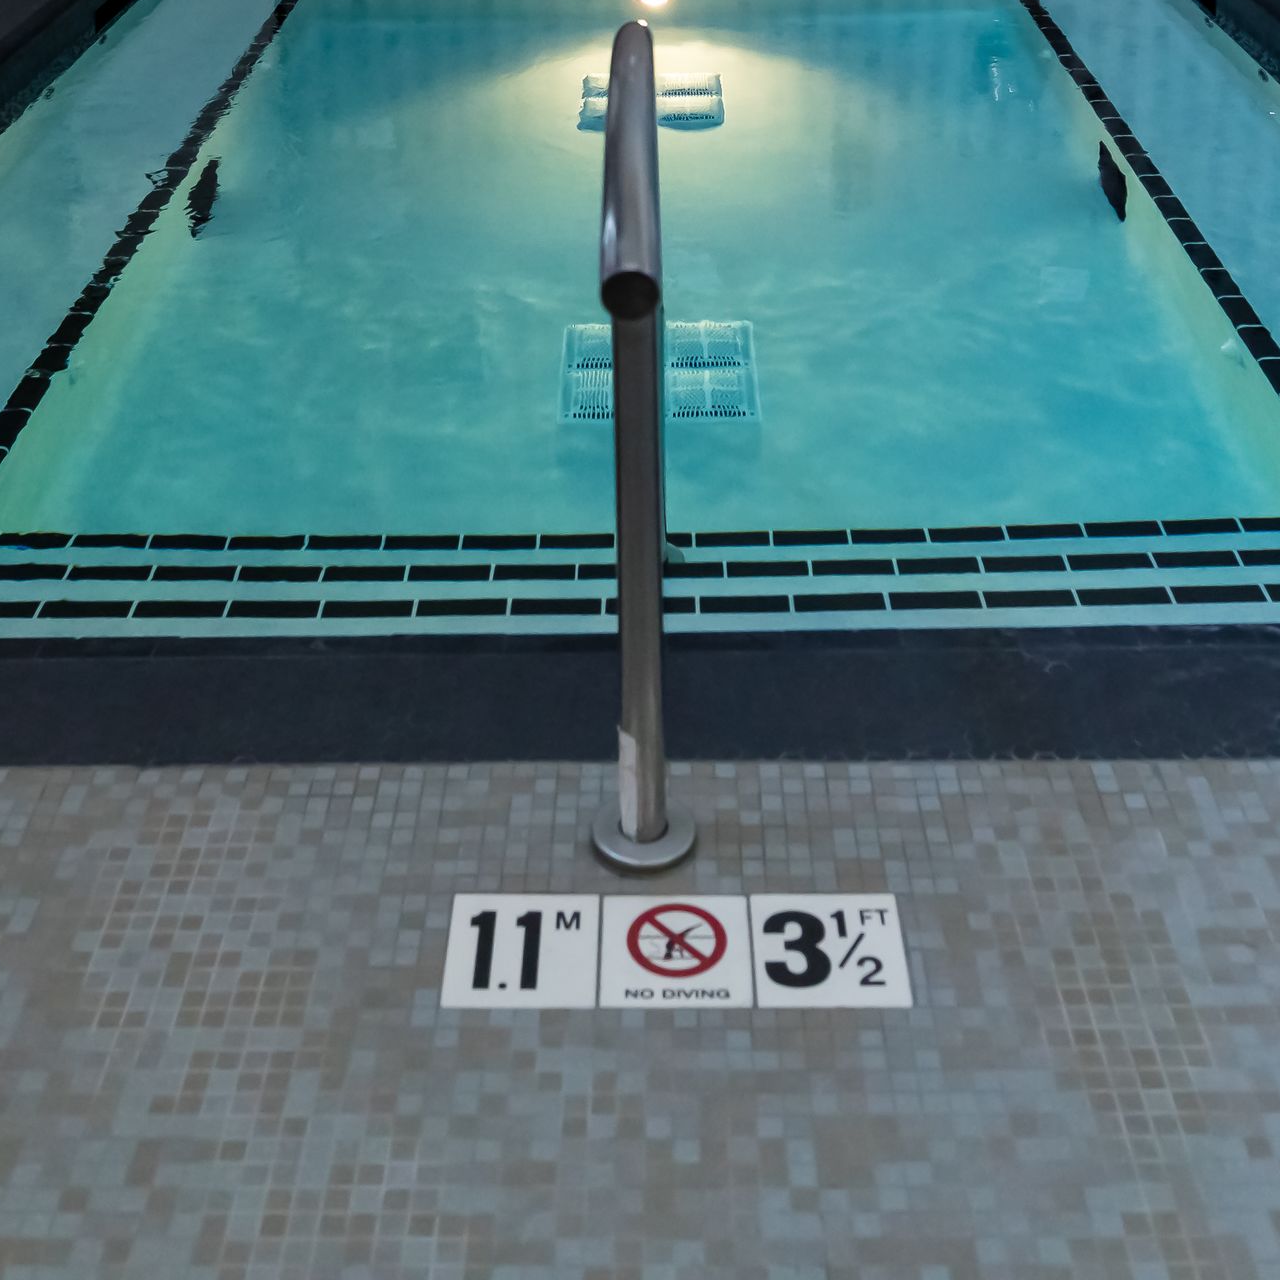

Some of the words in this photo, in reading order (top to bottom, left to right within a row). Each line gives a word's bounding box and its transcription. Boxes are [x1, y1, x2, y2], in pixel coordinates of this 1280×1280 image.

[469, 909, 543, 990] 1.1
[555, 910, 581, 930] M
[623, 987, 655, 999] NO
[662, 987, 732, 1001] DIVING
